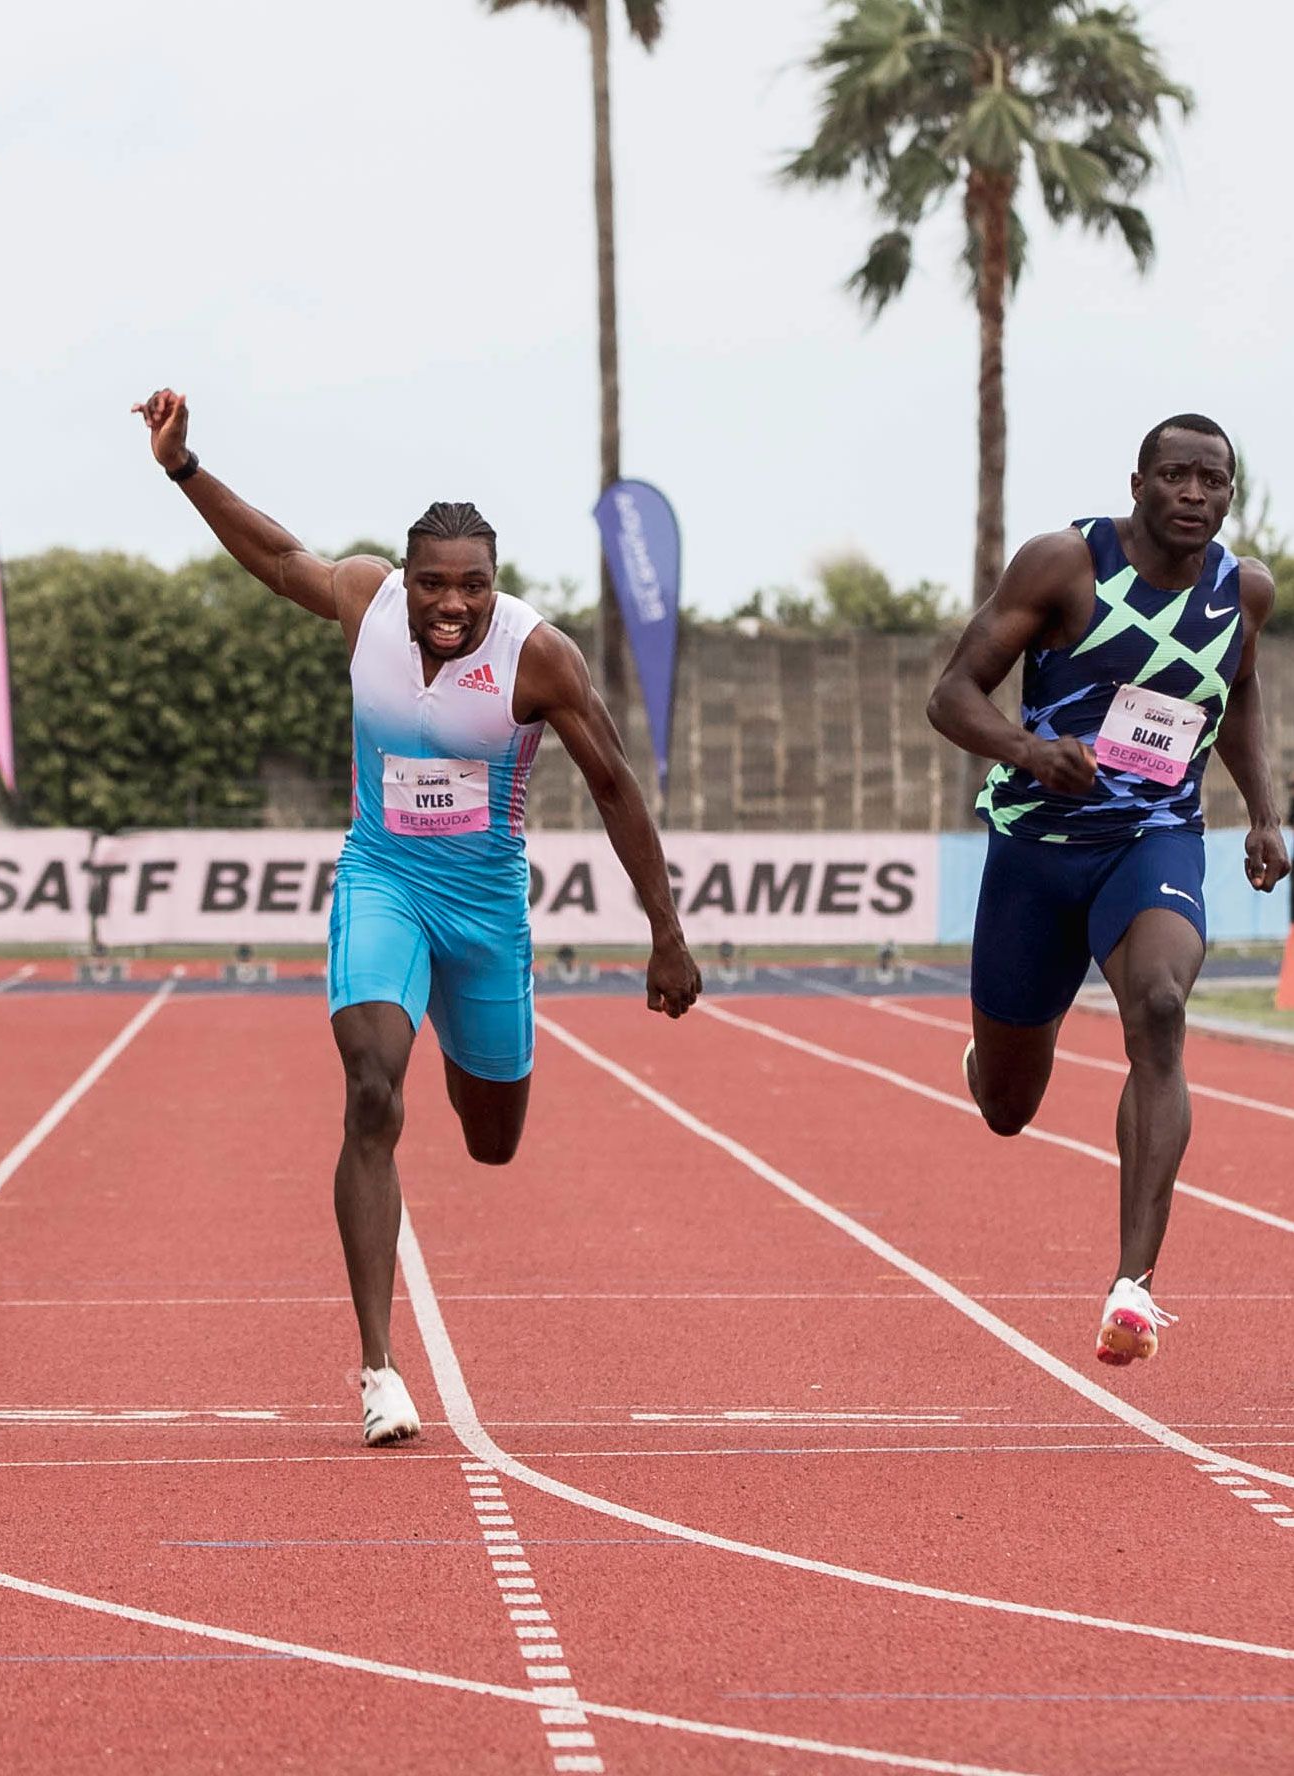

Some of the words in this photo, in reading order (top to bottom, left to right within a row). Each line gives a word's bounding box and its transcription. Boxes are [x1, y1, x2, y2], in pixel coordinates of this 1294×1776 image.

[458, 678, 500, 695] adidas
[1145, 712, 1174, 726] GAMES
[1132, 727, 1173, 751] BLAKE
[1109, 746, 1174, 774] BERMUDA
[417, 778, 450, 786] GAMES
[416, 793, 454, 808] LYLES
[400, 814, 471, 826] BERMUDA
